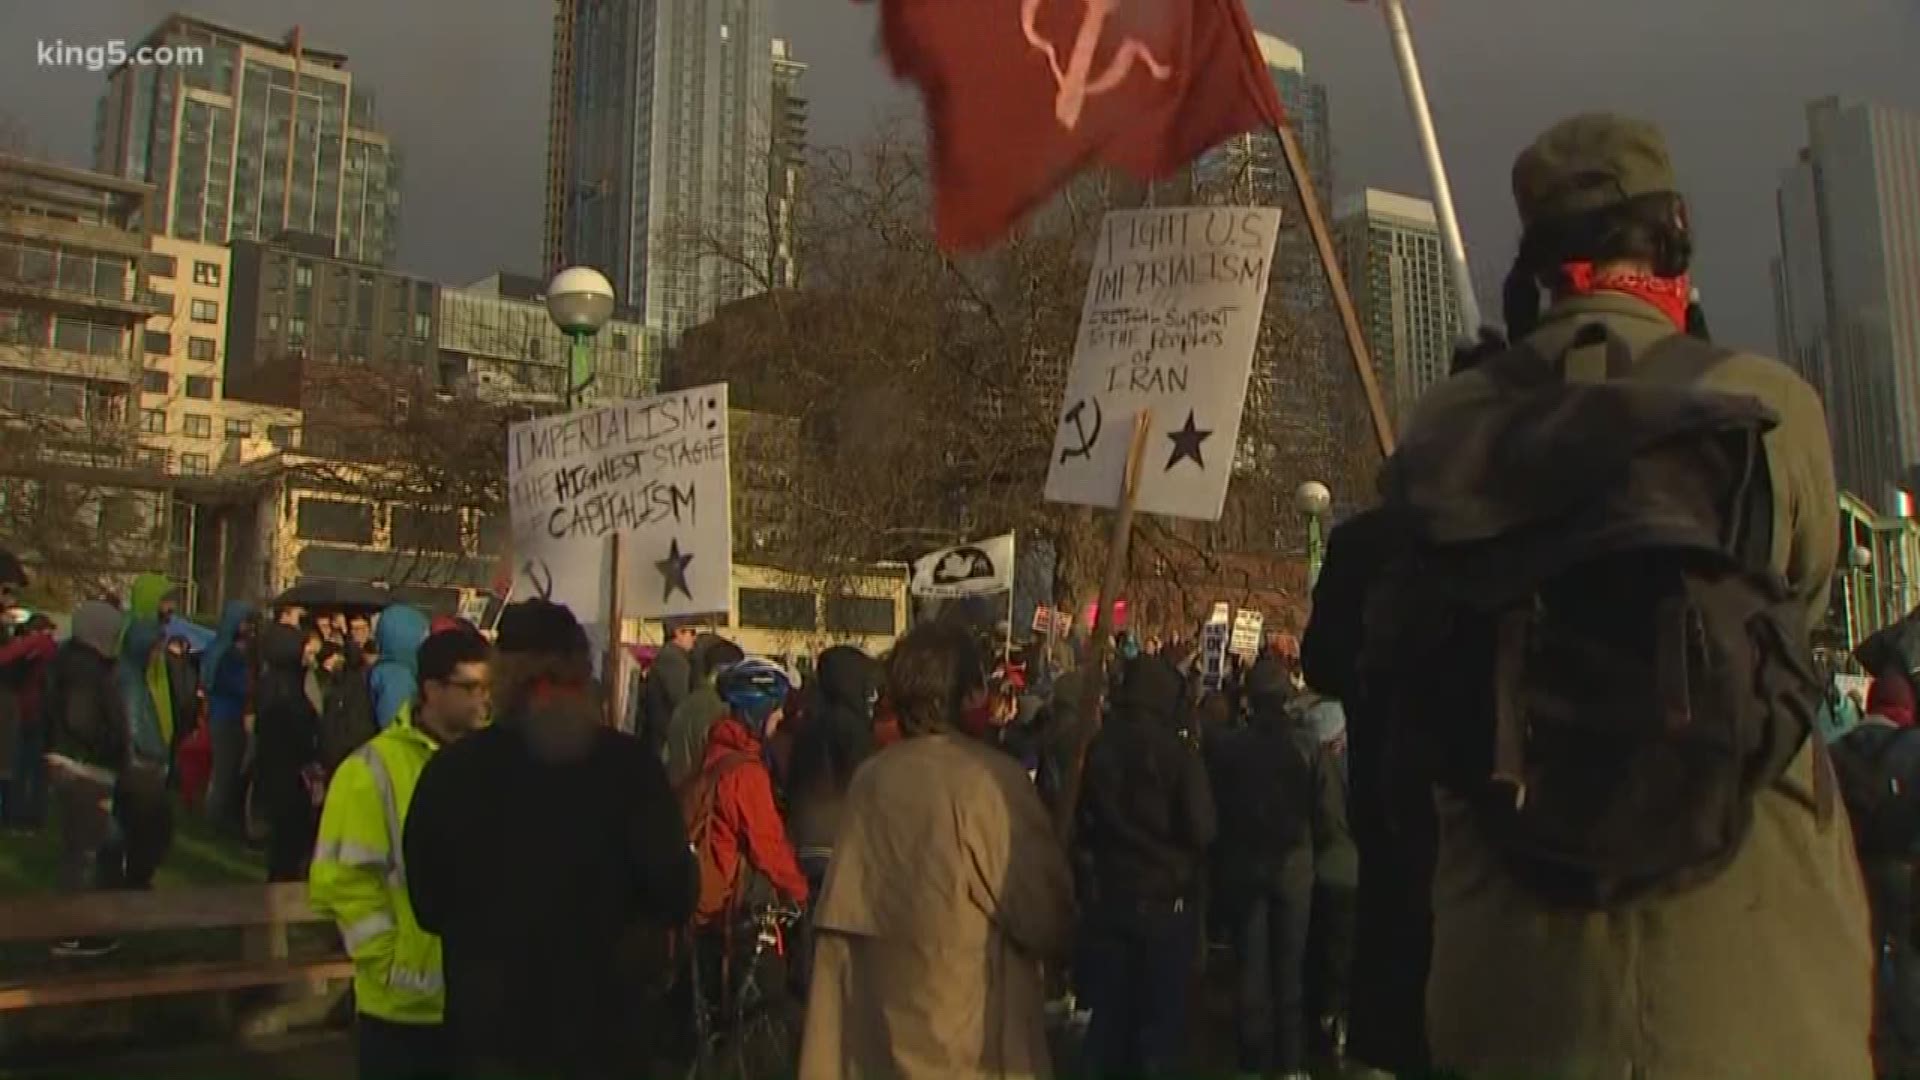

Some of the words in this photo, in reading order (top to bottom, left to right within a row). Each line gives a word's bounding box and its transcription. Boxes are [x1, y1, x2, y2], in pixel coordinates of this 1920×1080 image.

[1205, 211, 1264, 249] U.S
[1094, 251, 1264, 304] IMPERIALISM
[1106, 364, 1189, 394] IRAN
[555, 449, 647, 504] HIGHEST
[548, 481, 696, 539] CAPITALISM
